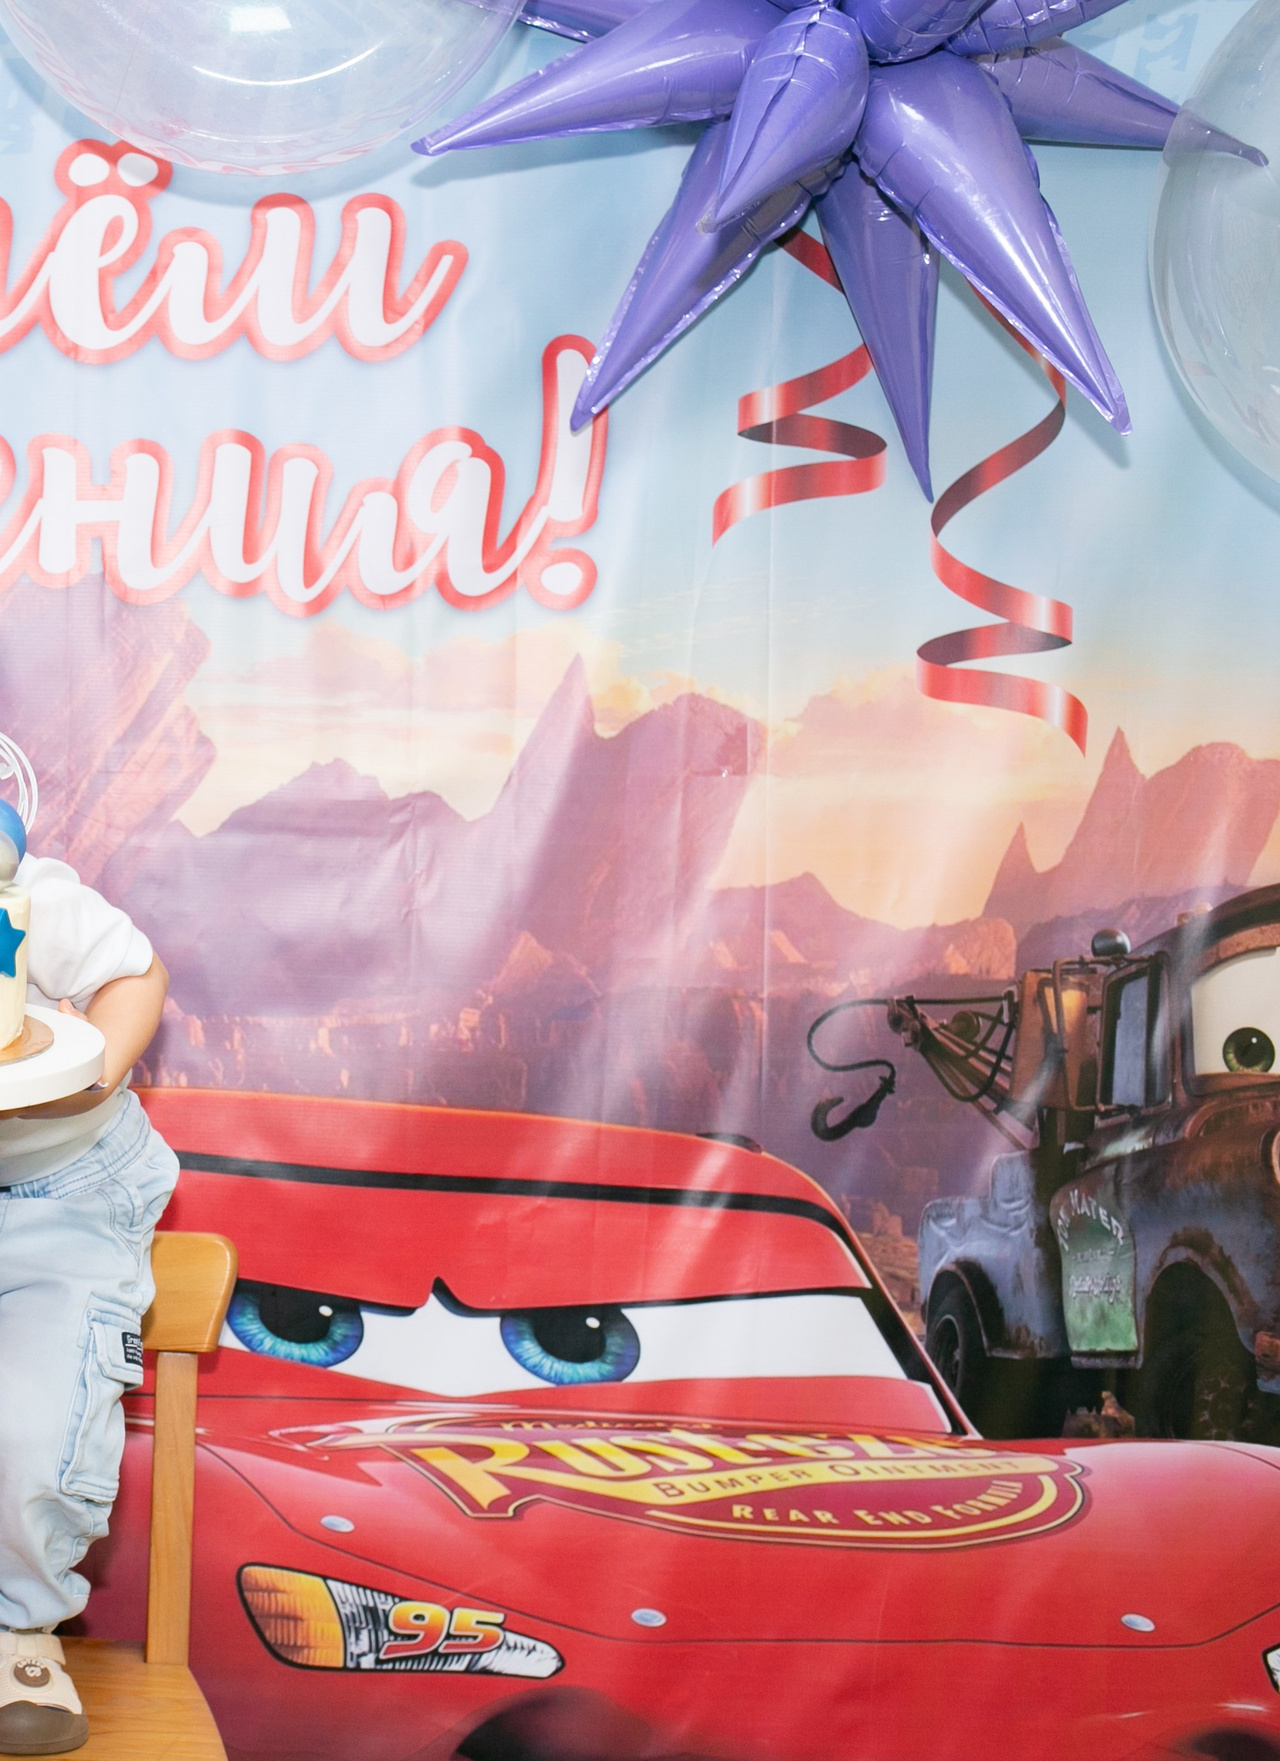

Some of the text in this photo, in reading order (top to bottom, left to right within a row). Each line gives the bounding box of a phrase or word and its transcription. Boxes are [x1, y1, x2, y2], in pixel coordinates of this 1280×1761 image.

[1069, 1189, 1124, 1245] MATER
[652, 1461, 1020, 1499] BUMPER OINTMENT
[732, 1504, 840, 1525] REAR
[853, 1509, 933, 1526] END
[379, 1601, 506, 1660] 95
